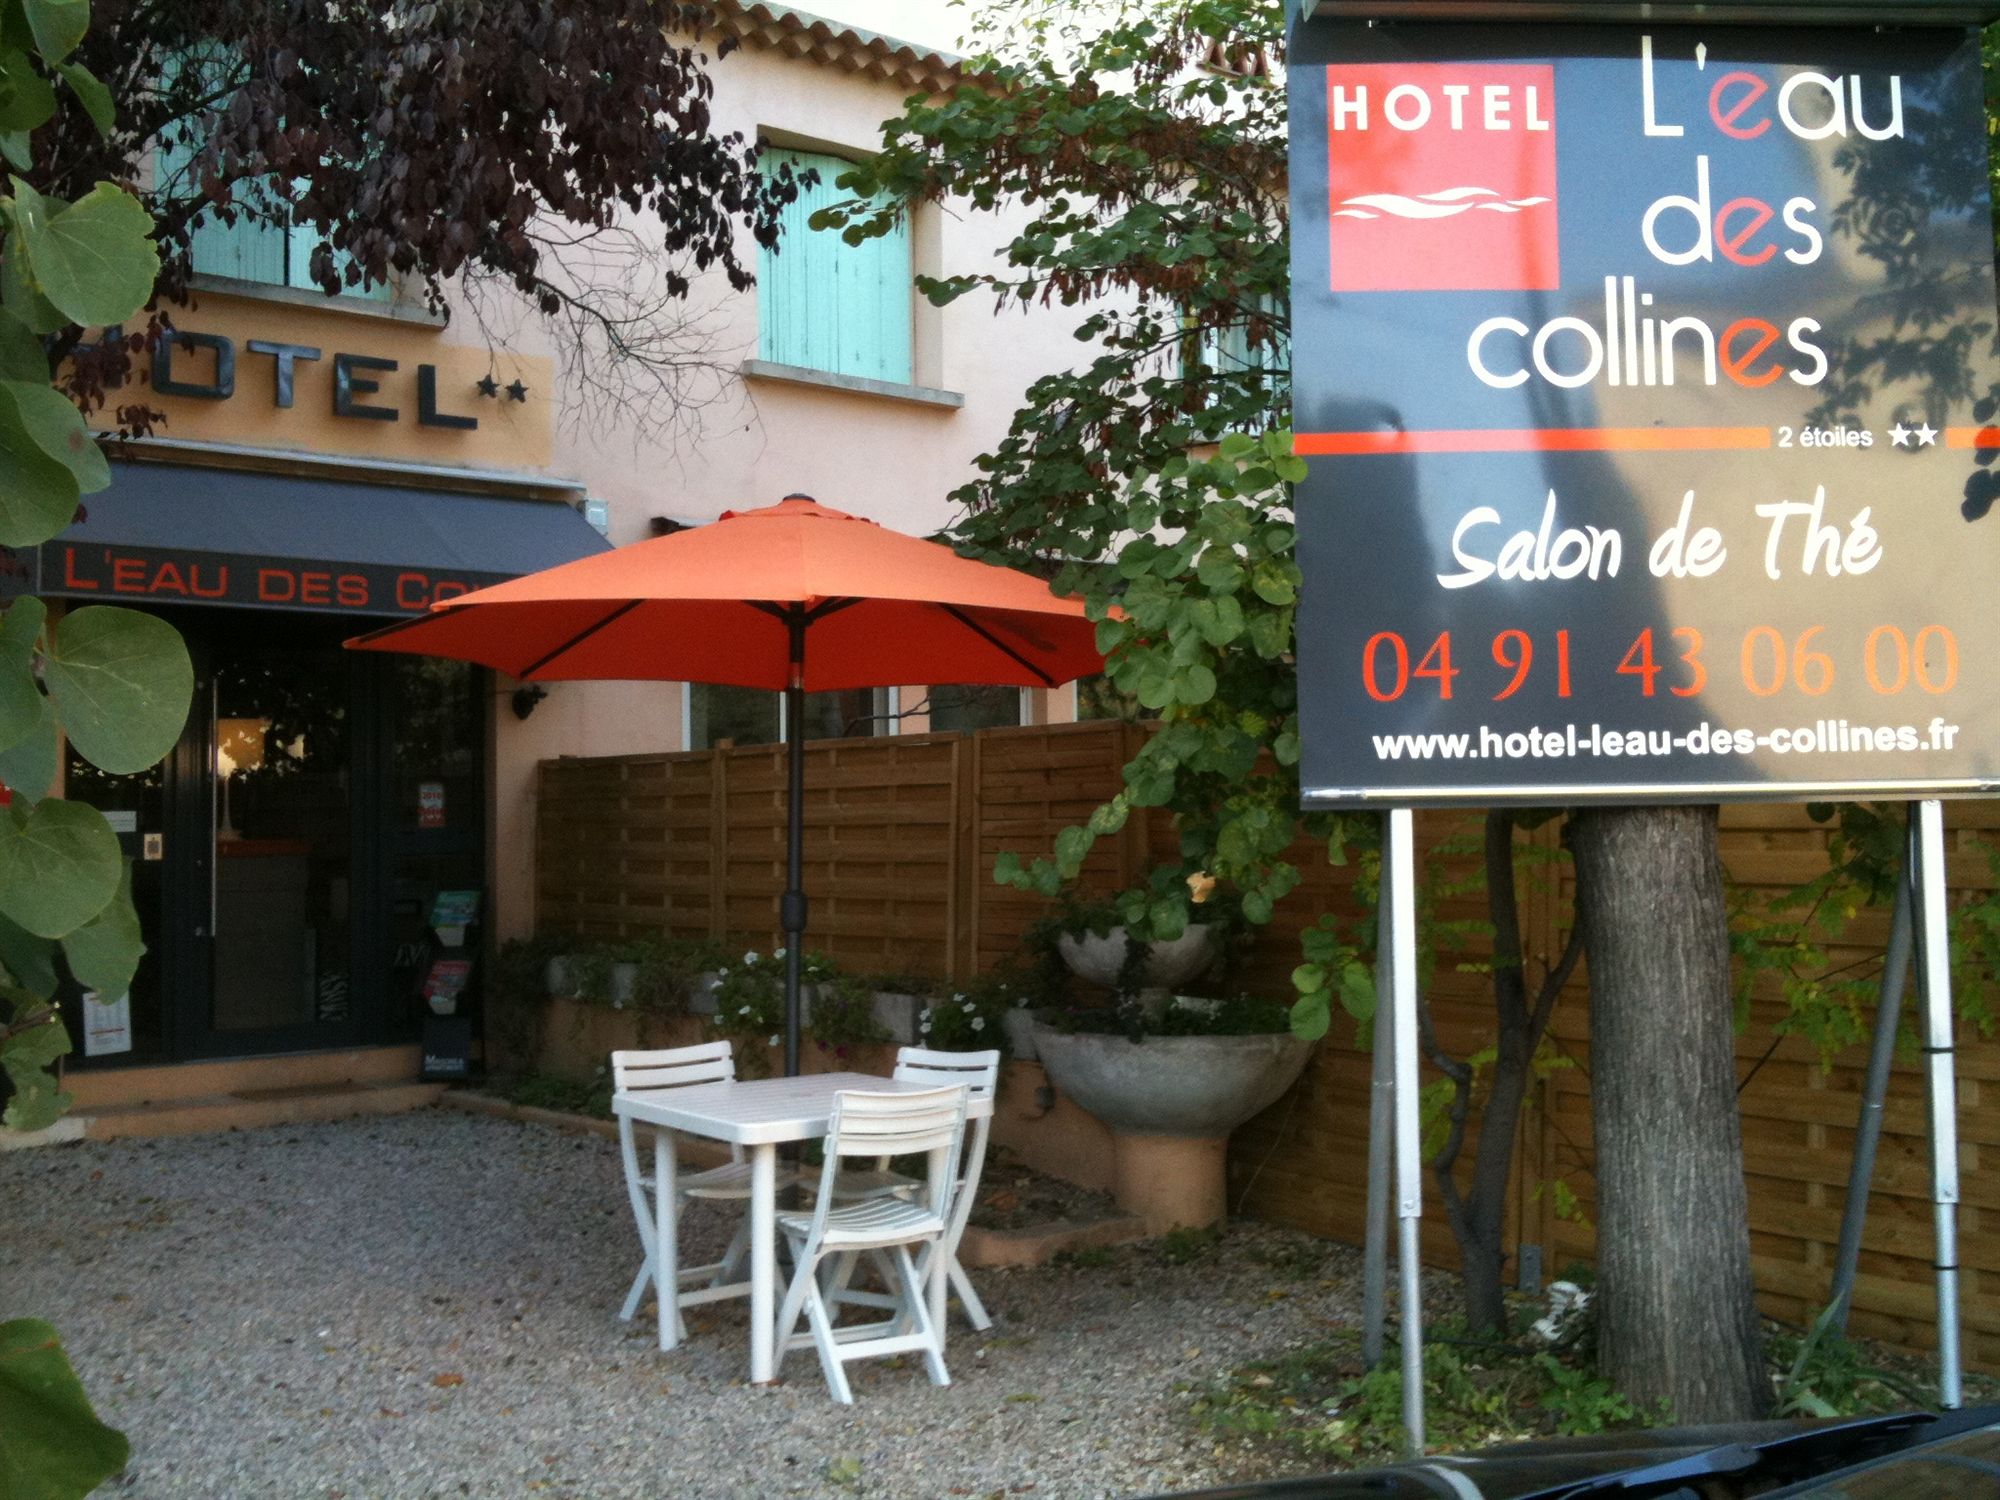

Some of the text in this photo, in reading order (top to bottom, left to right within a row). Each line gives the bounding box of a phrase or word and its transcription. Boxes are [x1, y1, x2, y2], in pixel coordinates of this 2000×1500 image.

[1332, 83, 1550, 132] HOTEL
[1641, 34, 1905, 141] L'eau
[1641, 154, 1824, 267] des
[1466, 275, 1829, 389] collines
[1778, 424, 1874, 448] 2 étoiles
[1436, 484, 1883, 590] Salon de Thé
[1361, 624, 1959, 701] 04 91 43 06 00
[1372, 717, 1960, 760] www.hotel-leau-des-collines.fr
